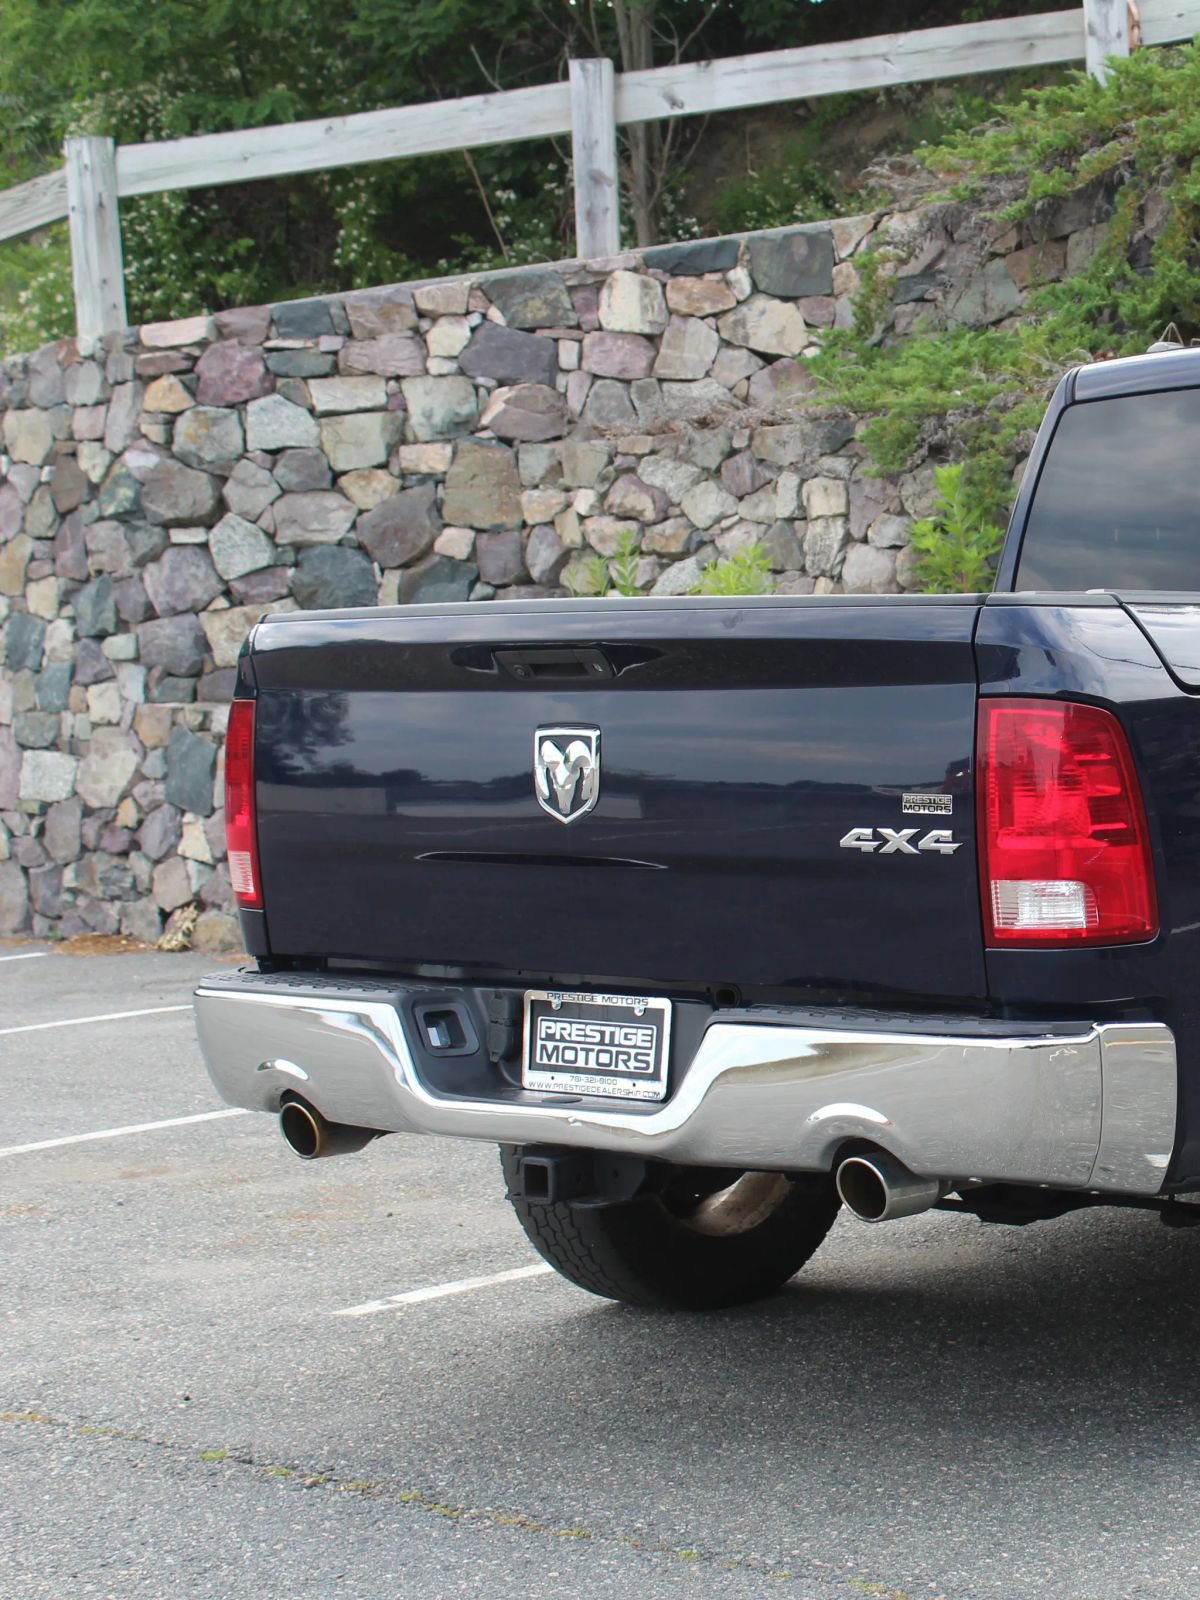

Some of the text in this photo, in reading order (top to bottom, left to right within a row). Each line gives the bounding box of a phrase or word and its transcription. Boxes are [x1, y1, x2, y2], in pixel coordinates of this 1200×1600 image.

[903, 795, 951, 804] PRESTIGE
[903, 804, 951, 813] MOTORS
[546, 992, 649, 1006] PRESTIGE MOTORS
[540, 1021, 652, 1047] PRESTIGE
[539, 1043, 651, 1071] MOTORS
[528, 1081, 661, 1098] WWW.PRESTIGEDEALERSHIP.COM
